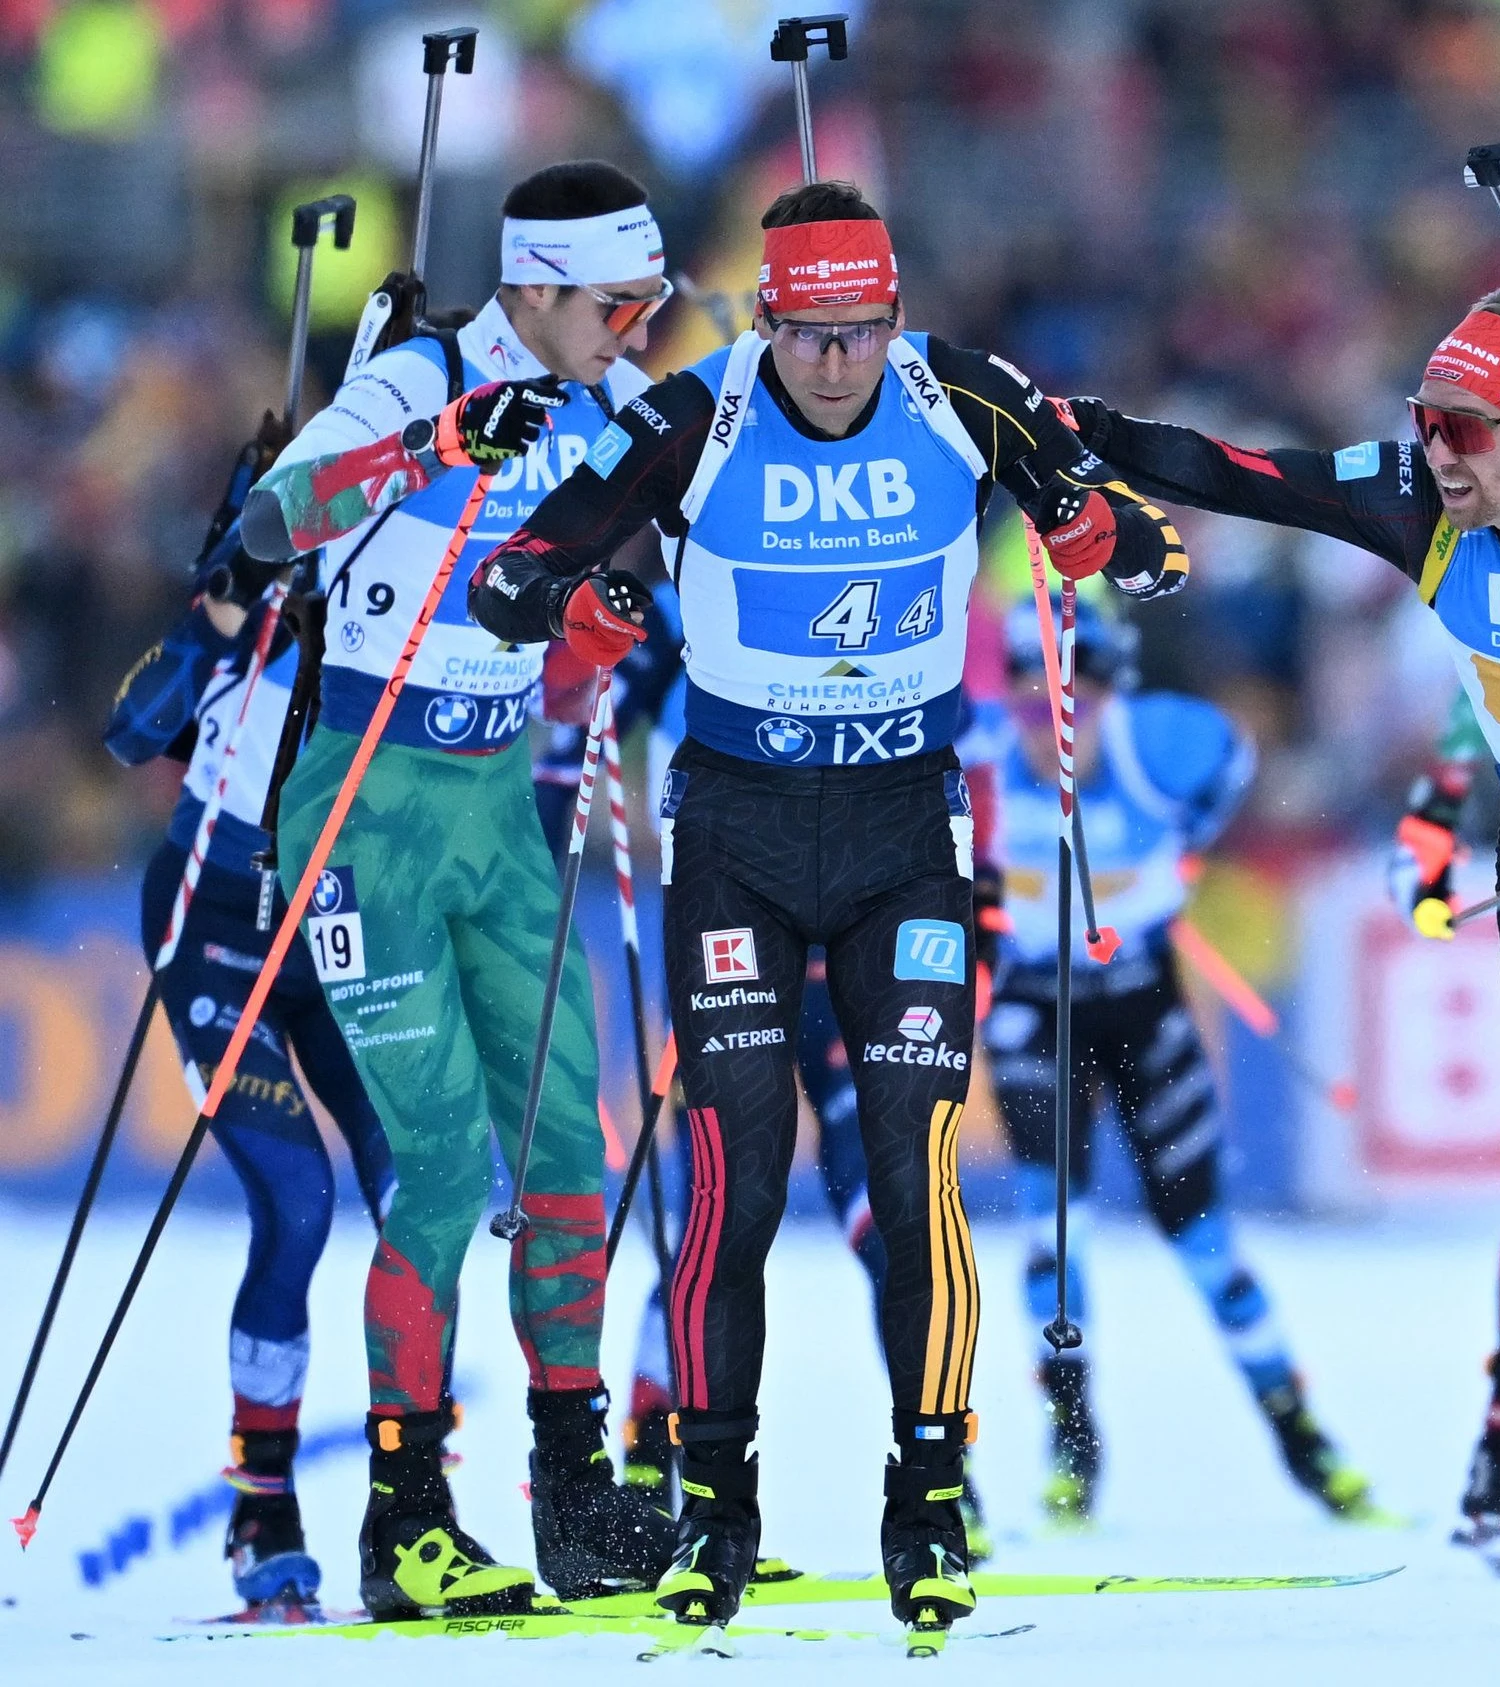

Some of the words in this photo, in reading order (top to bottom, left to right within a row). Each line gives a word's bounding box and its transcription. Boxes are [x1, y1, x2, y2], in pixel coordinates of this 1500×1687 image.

[788, 259, 879, 280] VIESSMANN
[790, 277, 879, 292] Wärmepumpen
[900, 359, 942, 410] JOKA
[712, 394, 743, 448] JOKA
[763, 458, 916, 523] DKB
[485, 500, 513, 518] Das
[762, 531, 803, 551] Das
[809, 531, 861, 550] kann
[867, 524, 920, 548] Bank
[1049, 516, 1094, 548] Roeckl
[809, 578, 882, 652] 4
[895, 585, 938, 641] 4
[767, 670, 924, 700] CHIEMGAU
[766, 691, 922, 712] RUHPOLDING
[832, 709, 926, 764] iX3
[314, 923, 352, 972] 19
[908, 928, 959, 976] TQ
[331, 969, 425, 1003] MOTO-PFOHE
[691, 987, 777, 1012] Kaufland
[724, 1027, 786, 1051] TERREX
[862, 1041, 968, 1072] tectake
[445, 1619, 526, 1634] FISCHER
